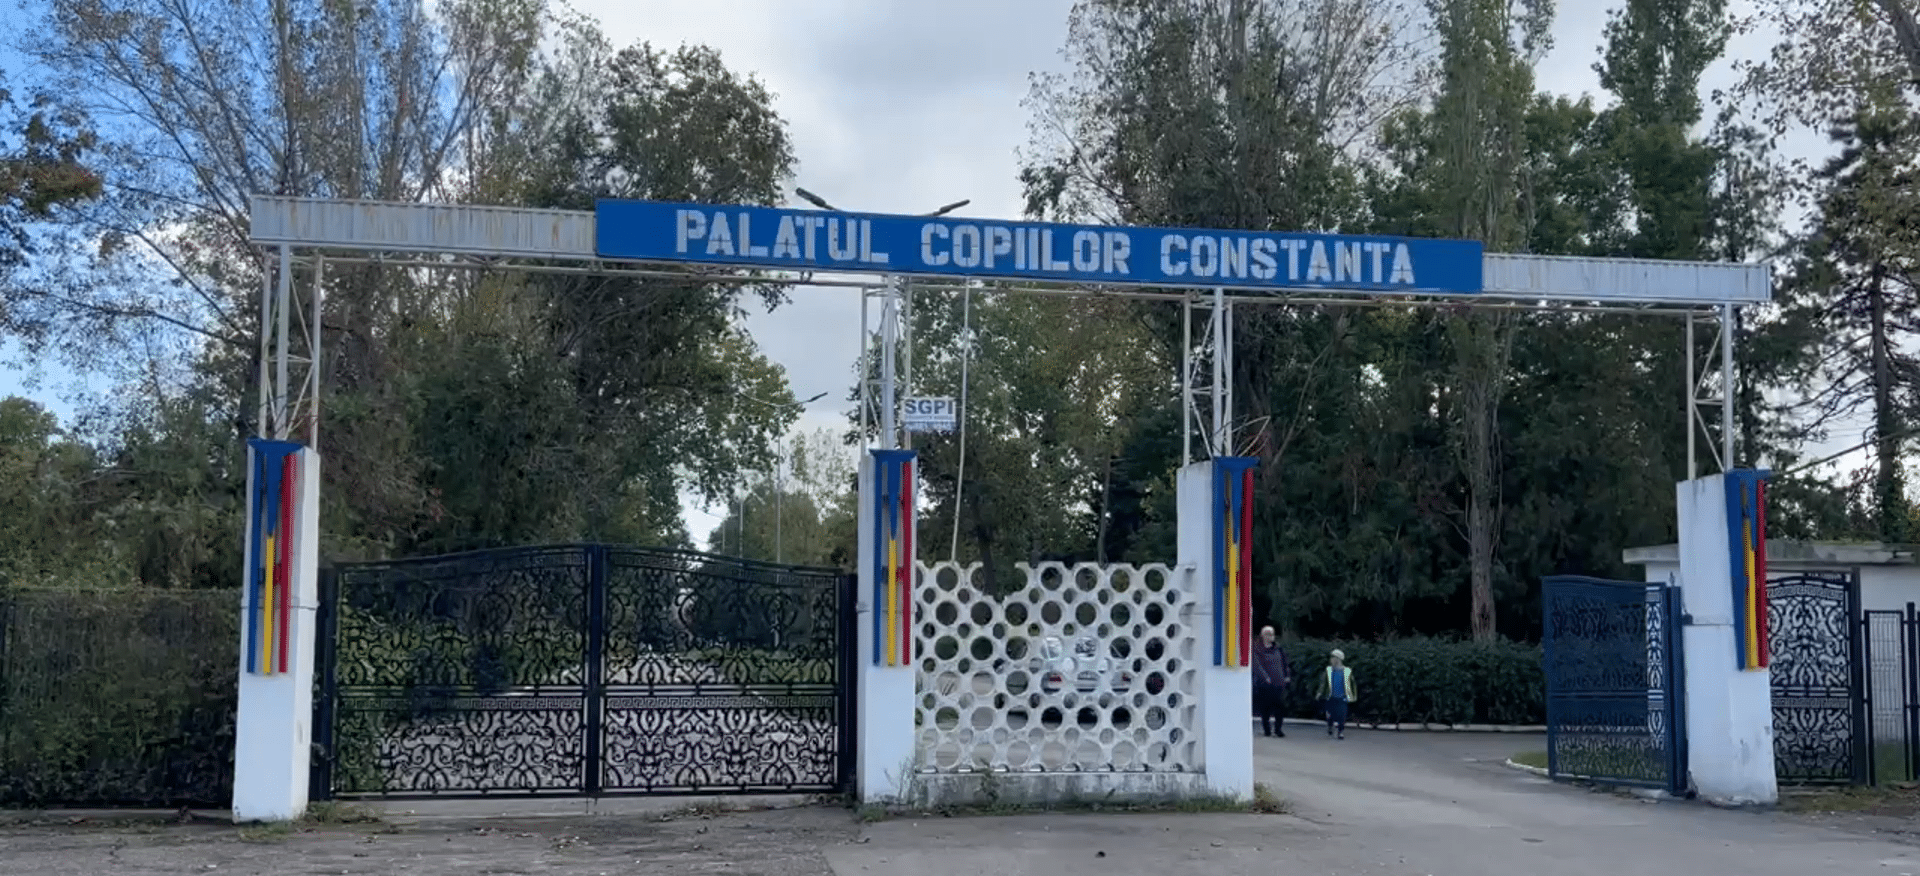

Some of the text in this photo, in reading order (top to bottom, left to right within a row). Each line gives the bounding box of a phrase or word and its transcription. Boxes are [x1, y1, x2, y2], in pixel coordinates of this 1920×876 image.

[676, 209, 1415, 285] PALATUL COPIILOR CONSTANTA
[905, 399, 953, 414] SGPI
